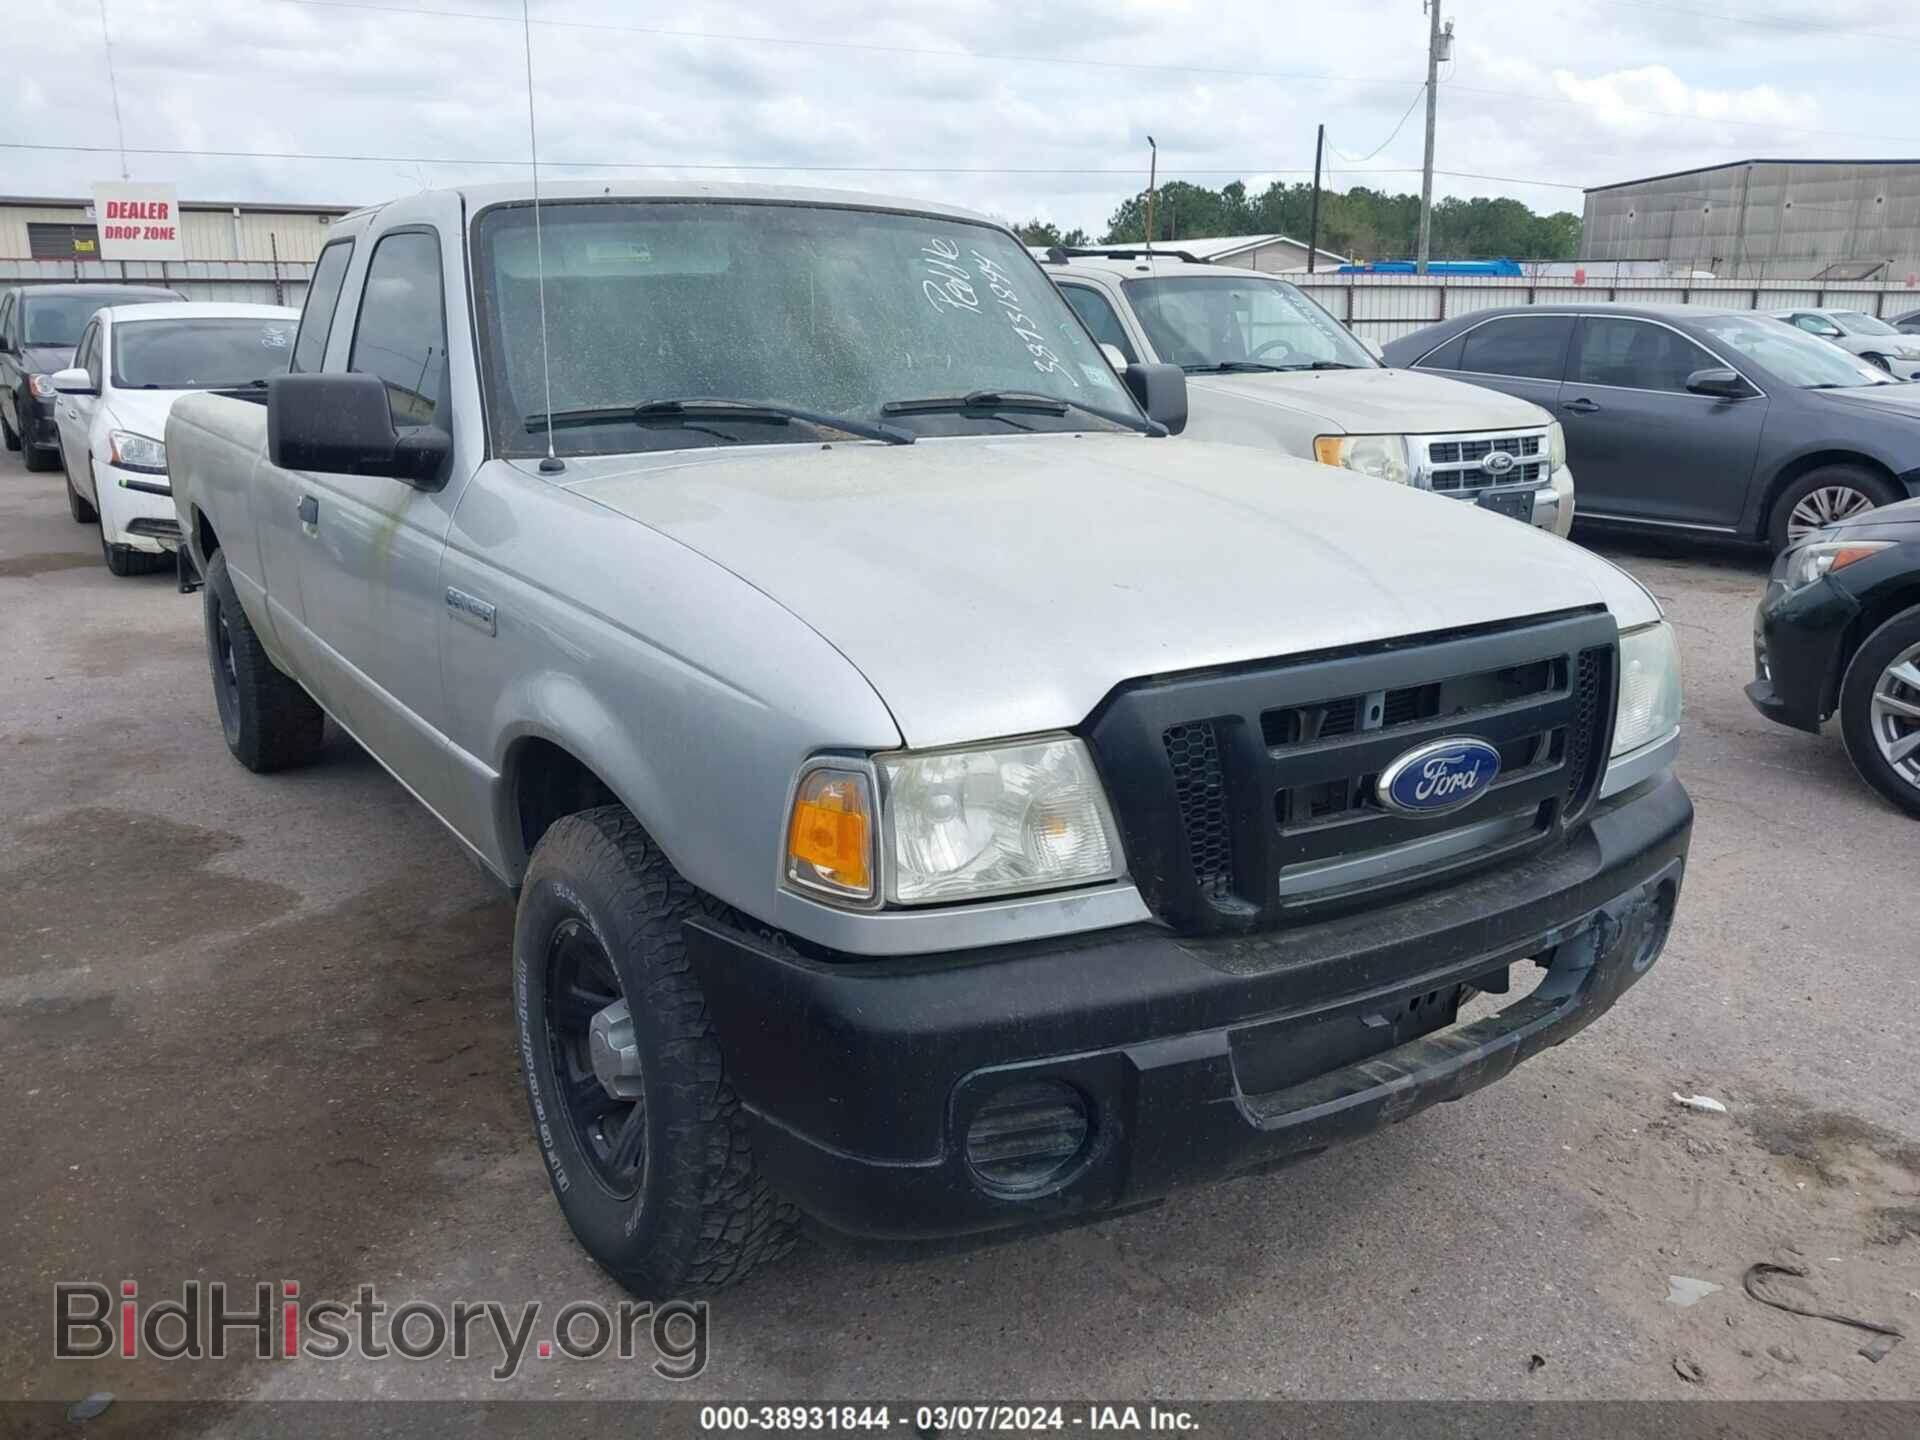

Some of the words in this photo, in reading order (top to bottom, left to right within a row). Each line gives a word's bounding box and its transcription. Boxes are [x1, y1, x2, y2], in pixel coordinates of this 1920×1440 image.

[106, 201, 169, 220] DEALER
[105, 226, 141, 240] DROP
[143, 227, 176, 240] ZONE
[1415, 754, 1481, 800] Ford
